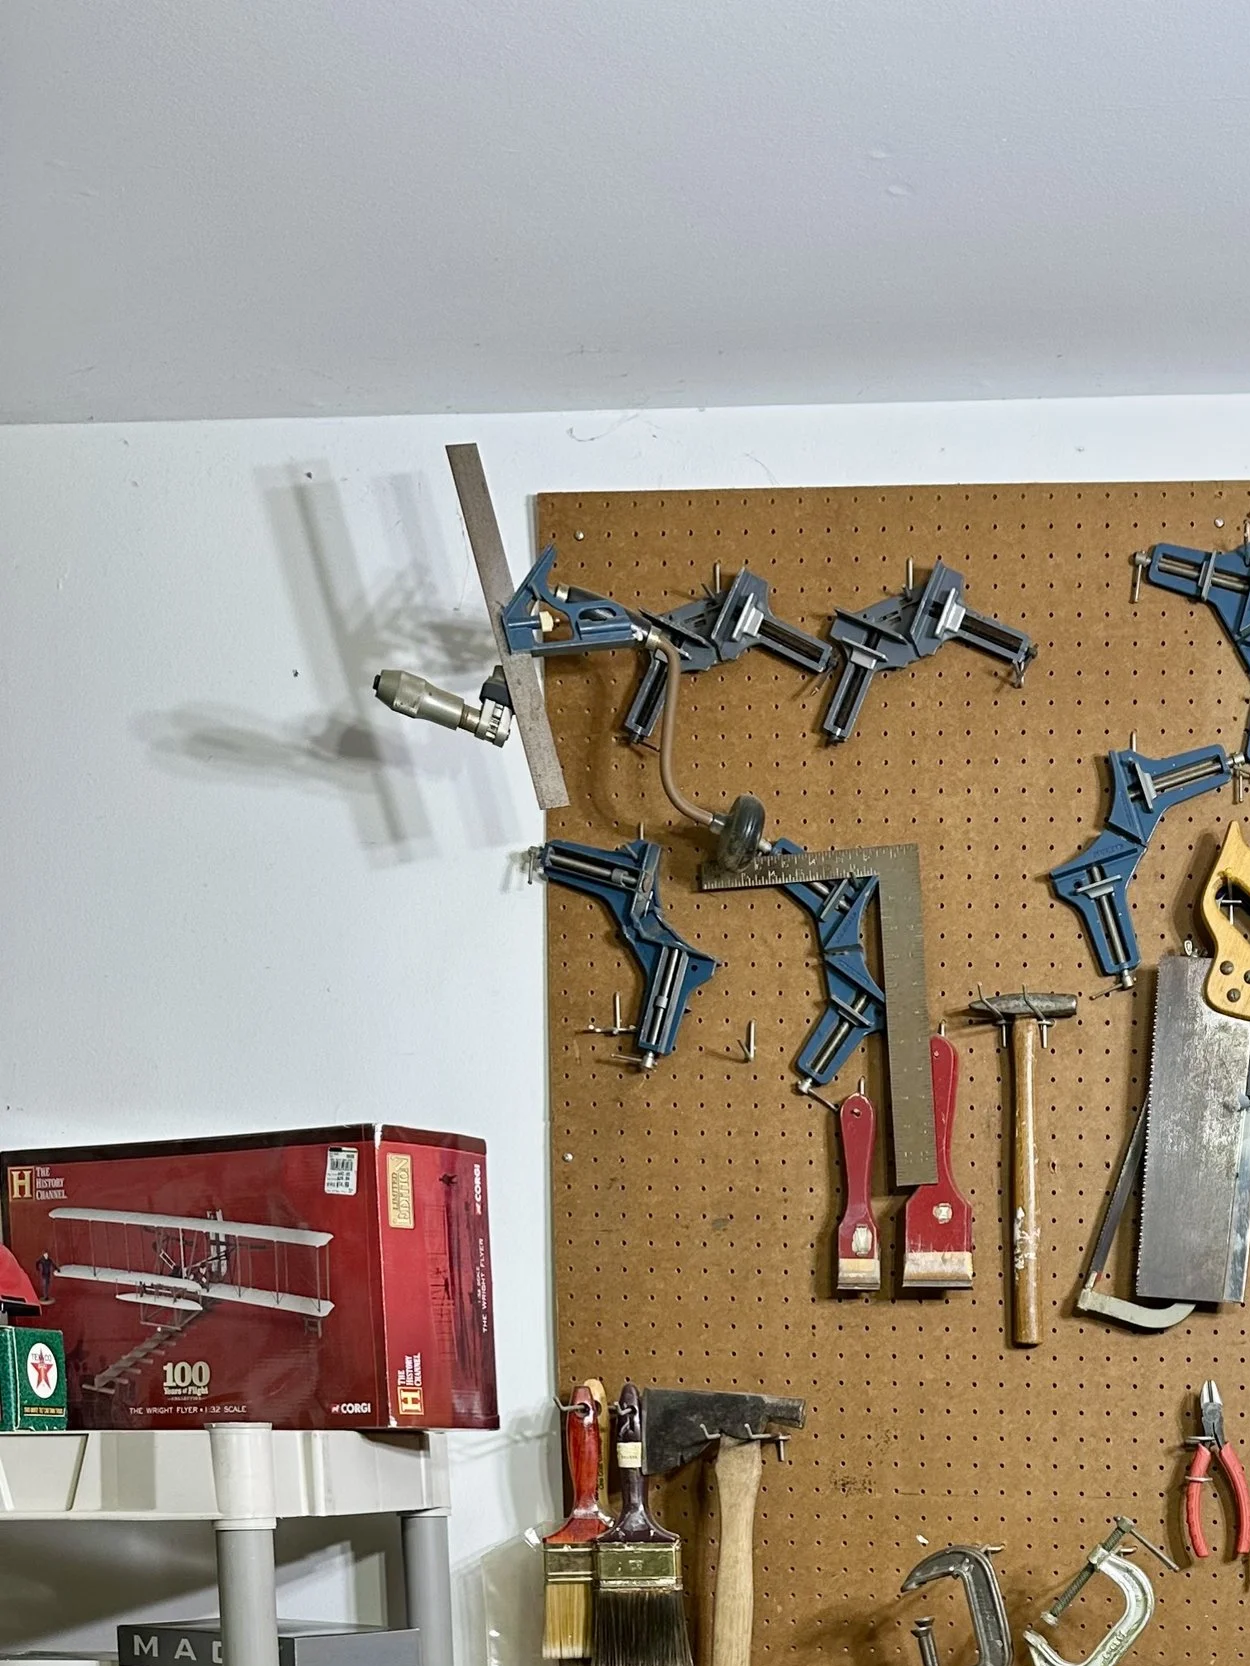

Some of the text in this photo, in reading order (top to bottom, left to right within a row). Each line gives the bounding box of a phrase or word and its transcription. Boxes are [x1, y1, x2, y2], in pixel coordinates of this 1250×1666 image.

[36, 1167, 50, 1177] THE
[36, 1178, 64, 1189] HISTORY
[36, 1189, 67, 1200] CHANNEL
[163, 1361, 210, 1388] 100
[405, 1355, 414, 1386] HISTORY
[413, 1352, 422, 1387] CHANNEL
[164, 1386, 208, 1396] Years Flight
[176, 1406, 198, 1414] FLYER
[223, 1405, 247, 1413] SCALE
[341, 1403, 371, 1414] CORGI
[133, 1635, 223, 1664] MAC
